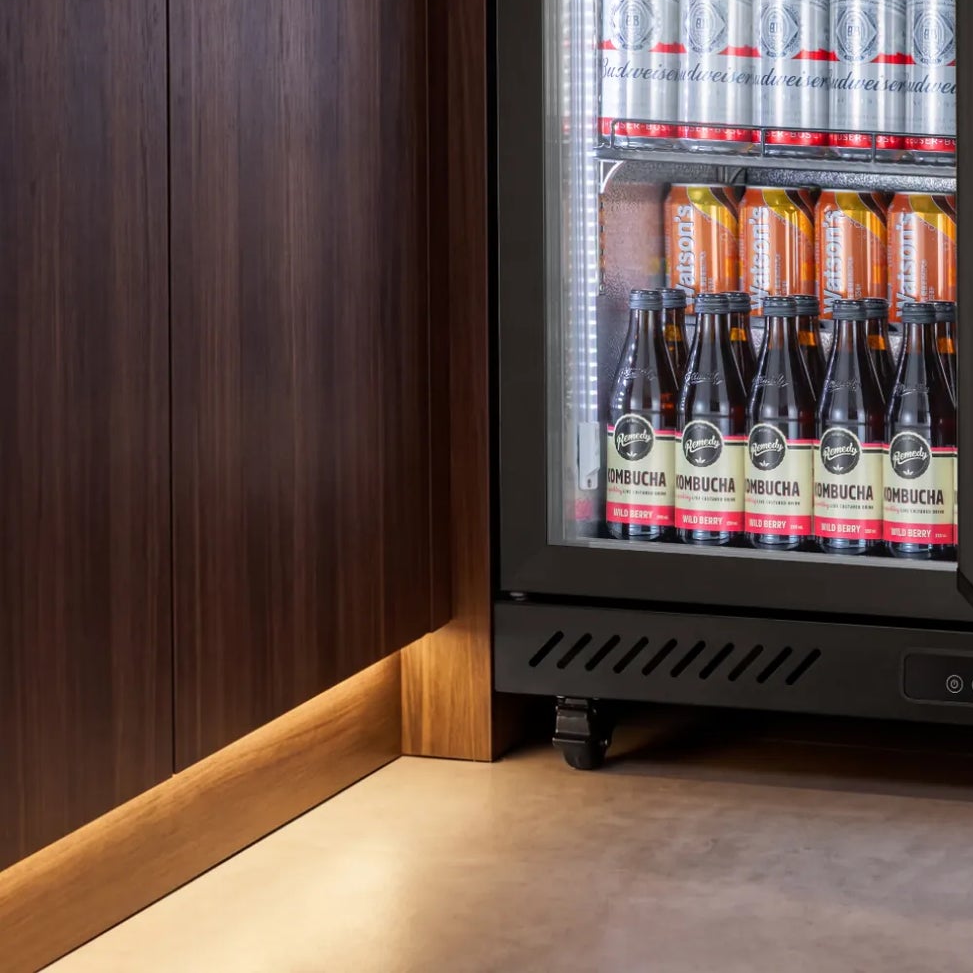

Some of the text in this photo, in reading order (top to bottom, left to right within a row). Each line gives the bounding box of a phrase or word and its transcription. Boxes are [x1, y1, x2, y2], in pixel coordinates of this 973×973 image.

[616, 429, 651, 451] Remedy
[685, 435, 720, 457] Remedy
[751, 438, 783, 463] Remedy
[823, 442, 858, 465] Remedy
[893, 446, 927, 469] Remedy
[676, 474, 736, 493] KOMBUCHA
[746, 479, 800, 497] OMBUCHA
[613, 508, 629, 517] WILD
[630, 509, 653, 518] BERRY
[683, 515, 723, 525] WILD BERRY
[749, 519, 787, 529] WILD BERRY
[821, 523, 861, 533] WILD BERRY
[891, 527, 932, 537] WILD BERRY
